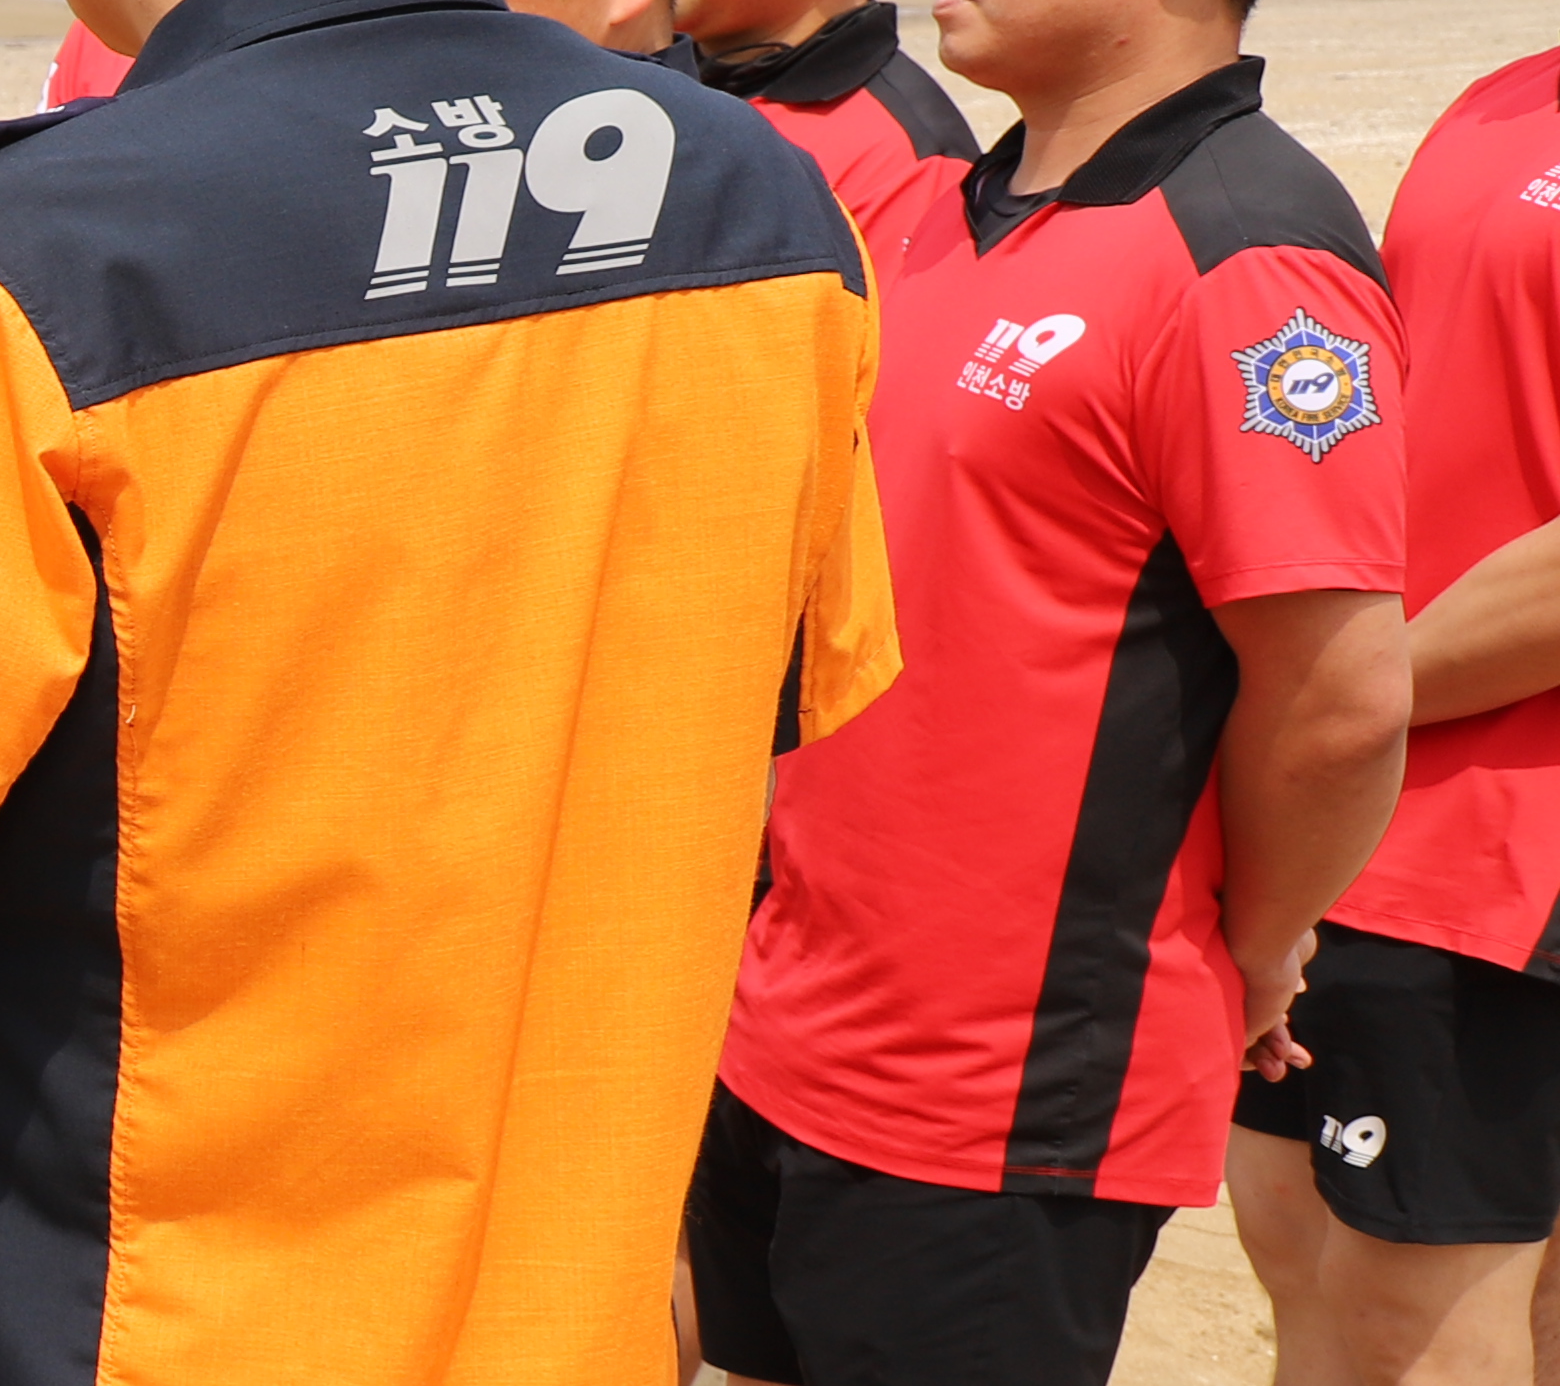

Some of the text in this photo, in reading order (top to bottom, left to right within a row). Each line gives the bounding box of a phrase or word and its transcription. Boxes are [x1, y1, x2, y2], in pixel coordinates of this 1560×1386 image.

[363, 95, 515, 162] 소방
[364, 88, 676, 300] 119
[973, 313, 1086, 377] 119
[956, 361, 1031, 411] 인천소방
[1286, 372, 1335, 395] 119
[1320, 1114, 1387, 1168] 119
